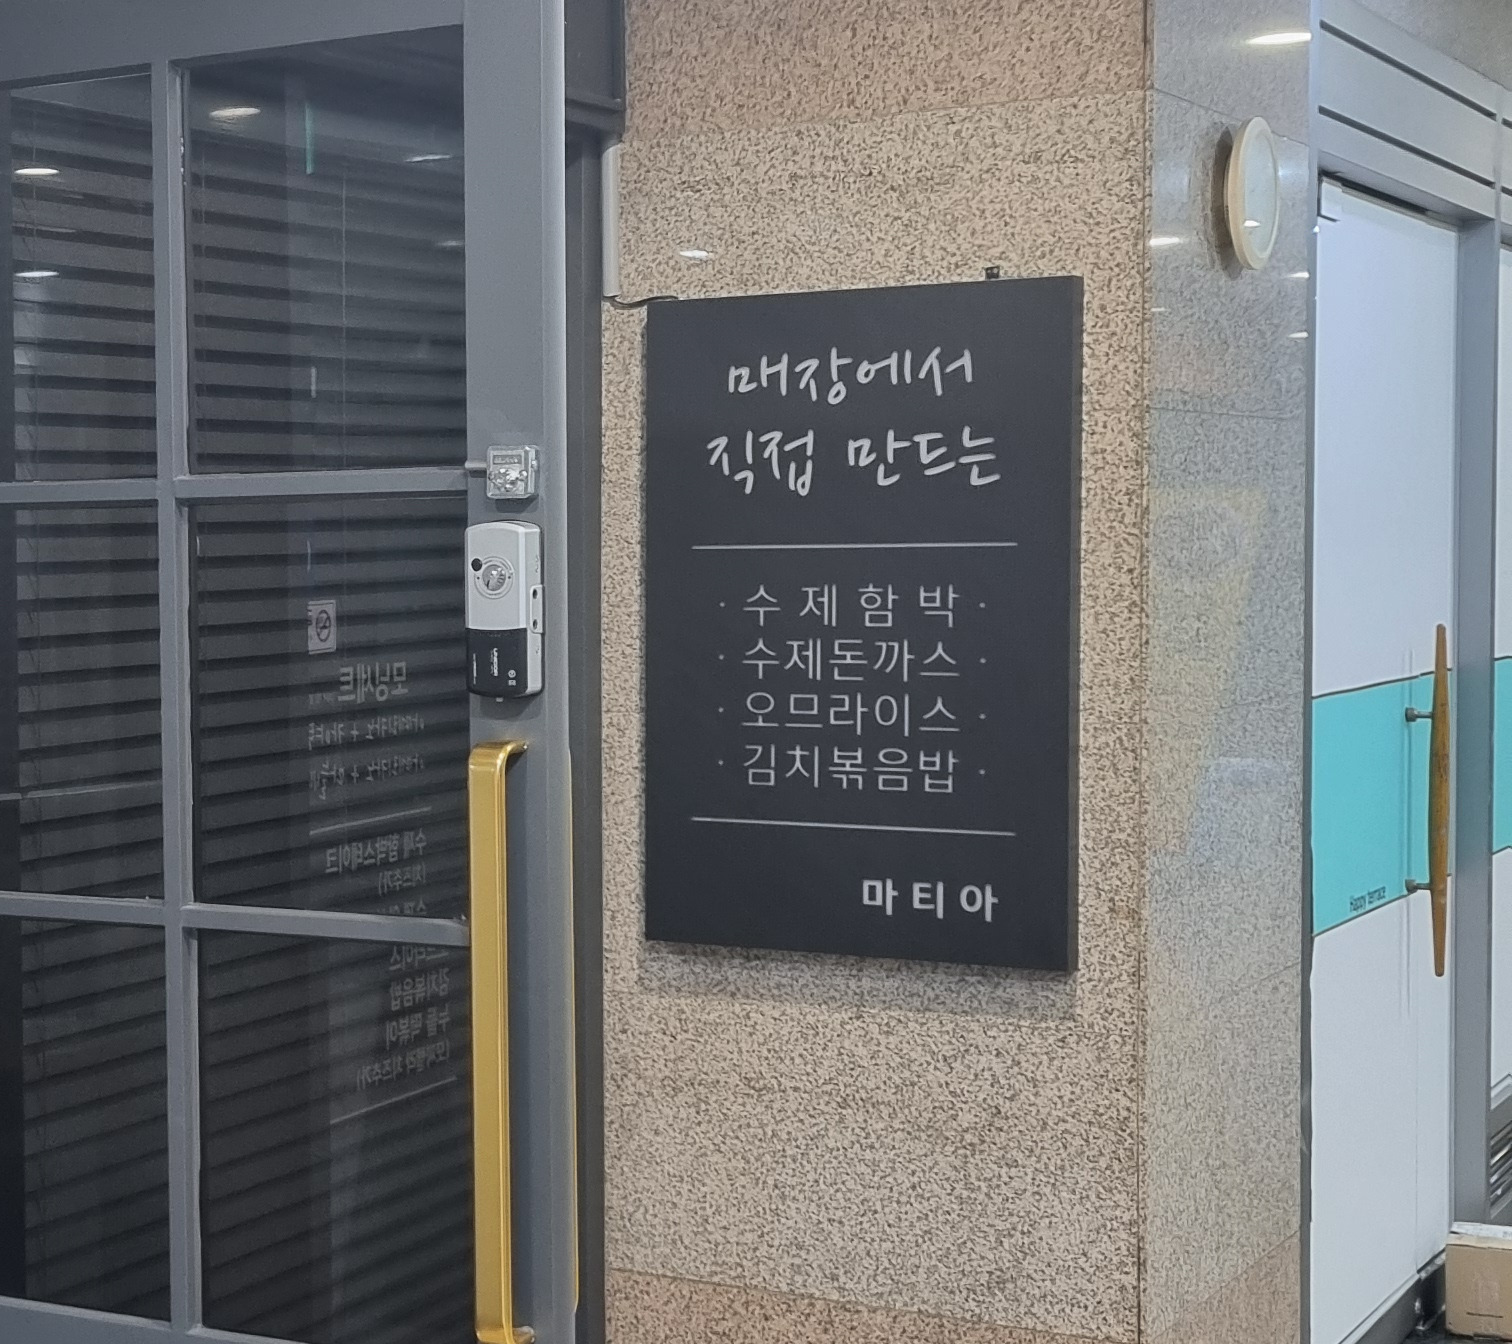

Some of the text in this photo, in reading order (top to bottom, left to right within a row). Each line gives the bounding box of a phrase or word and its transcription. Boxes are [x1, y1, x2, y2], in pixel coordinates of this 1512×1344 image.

[726, 346, 973, 405] 매장에서
[706, 426, 1001, 497] 직접 만드는
[741, 638, 960, 683] 수제돈까스
[741, 692, 960, 733] 오므라이스
[742, 744, 960, 793] 김치볶음밥
